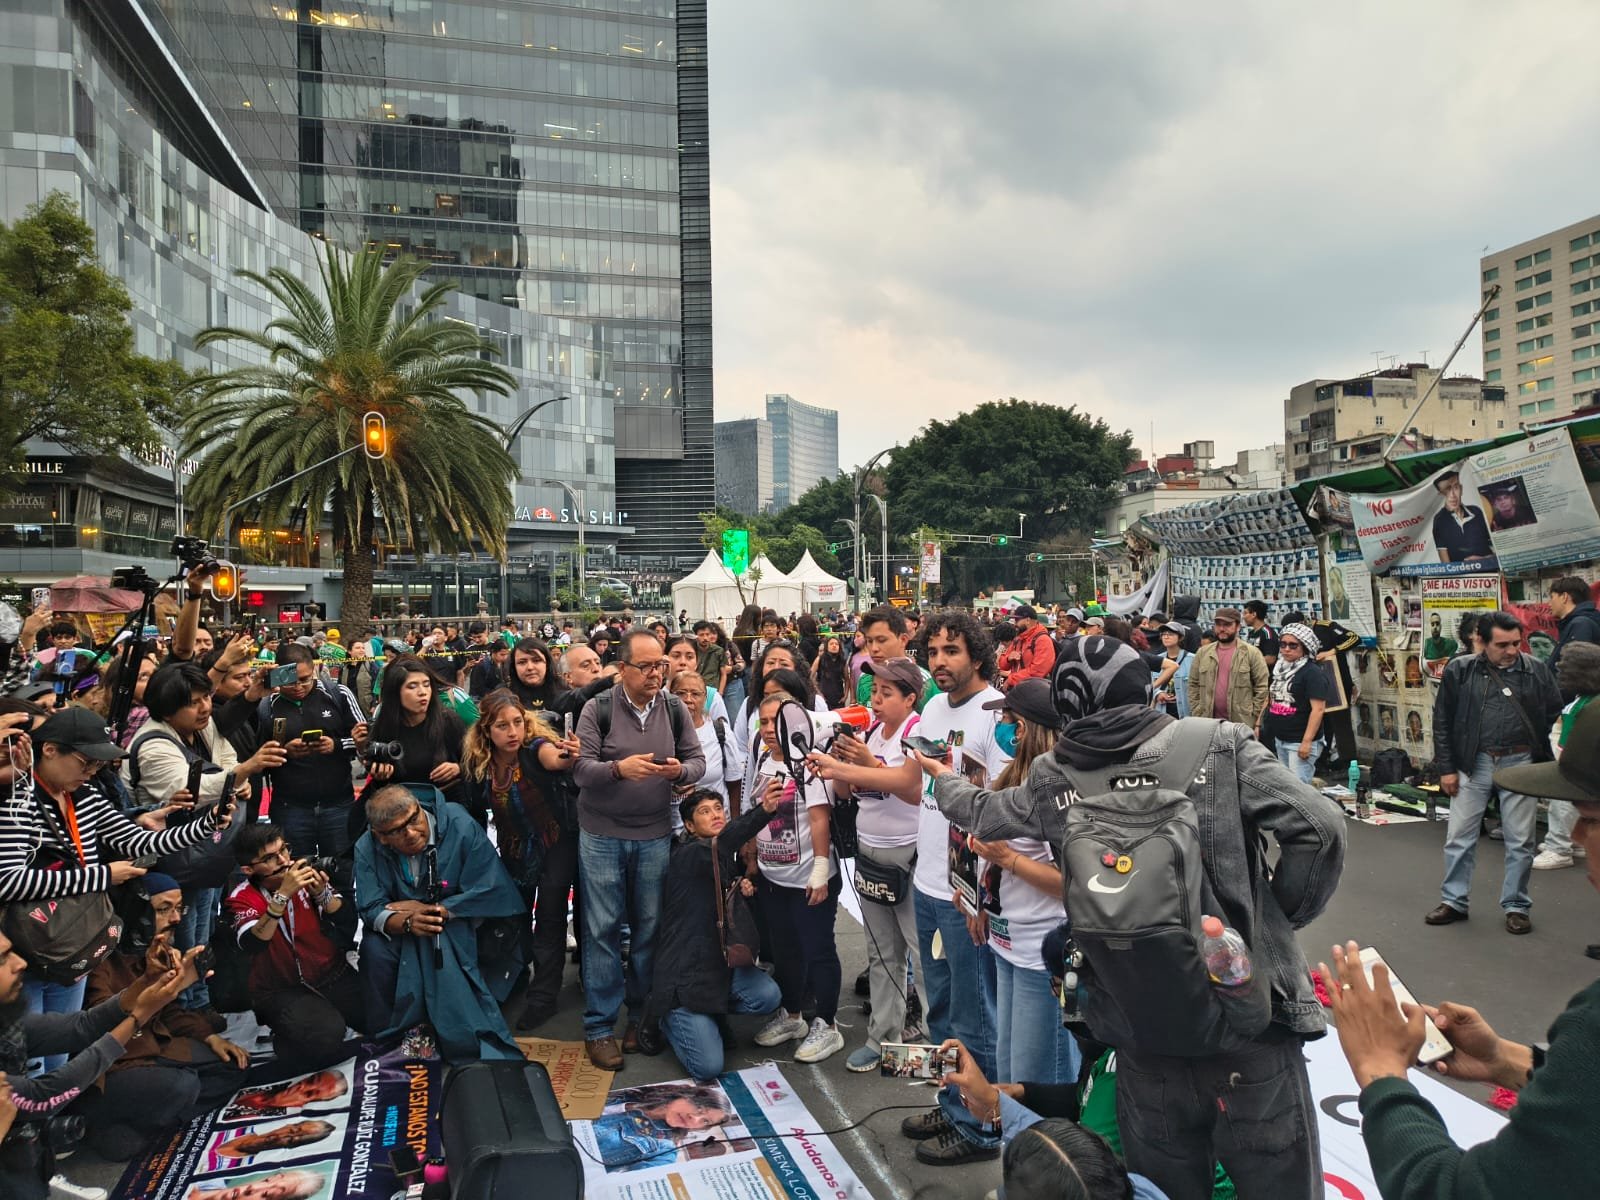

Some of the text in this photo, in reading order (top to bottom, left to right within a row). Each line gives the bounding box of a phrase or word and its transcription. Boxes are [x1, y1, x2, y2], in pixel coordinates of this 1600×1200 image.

[1357, 514, 1424, 537] descansaremos
[1381, 534, 1411, 550] hasta
[1423, 564, 1446, 577] Iglesias
[1447, 561, 1482, 575] Cordero
[1423, 578, 1497, 592] ¿ME HAS VISTO?
[1055, 788, 1081, 811] LIK
[404, 1064, 428, 1090] ¡NO
[406, 1091, 429, 1138] ESTAMOS
[347, 1142, 373, 1195] GONZÁLEZ
[762, 1137, 794, 1177] XIMENA
[789, 1127, 840, 1190] Ayúdanos
